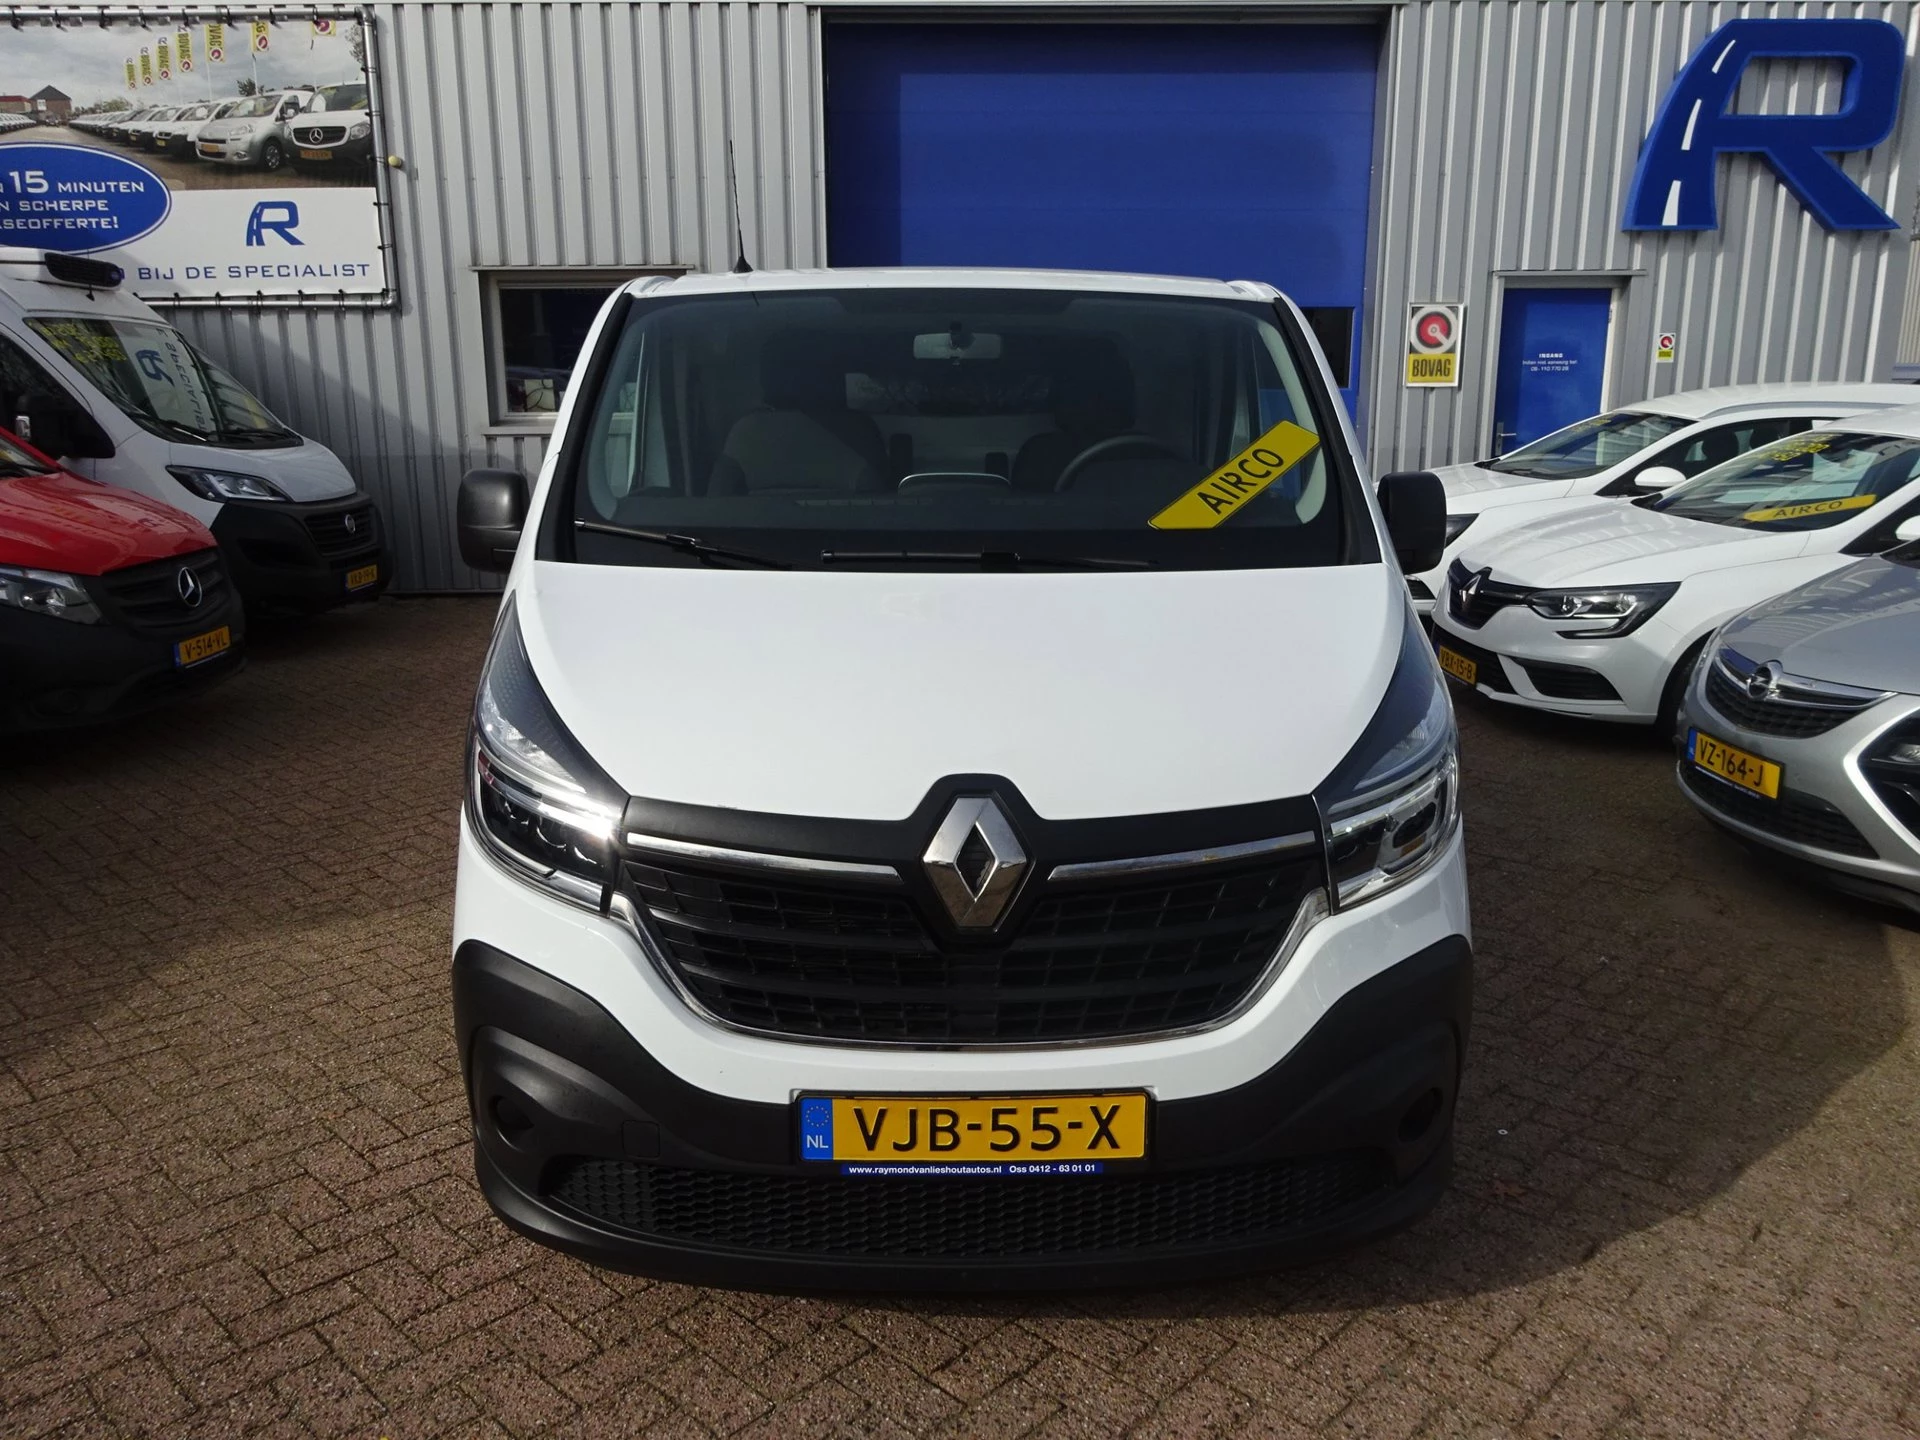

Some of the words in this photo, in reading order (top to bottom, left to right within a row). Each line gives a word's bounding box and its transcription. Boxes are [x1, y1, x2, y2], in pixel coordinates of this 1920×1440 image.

[9, 170, 49, 194] 15
[58, 181, 145, 193] MINUTEN
[19, 200, 109, 212] SCHERPE
[138, 267, 175, 280] BIJ
[186, 266, 217, 280] DE
[228, 264, 370, 279] SPECIALIST
[1412, 357, 1451, 378] BOVAG
[1197, 448, 1284, 515] AIRCO
[1773, 501, 1843, 518] AIRCO
[1700, 737, 1764, 787] VZ-164-J
[806, 1135, 829, 1149] NL
[853, 1104, 1121, 1152] VJB-55-X
[849, 1165, 1002, 1175] www.raymondvanlieshoutautos.nl
[1009, 1165, 1027, 1173] Oss
[1029, 1165, 1050, 1173] 0412
[1059, 1164, 1070, 1173] 63
[1072, 1164, 1083, 1173] 01
[1085, 1164, 1095, 1173] 01
